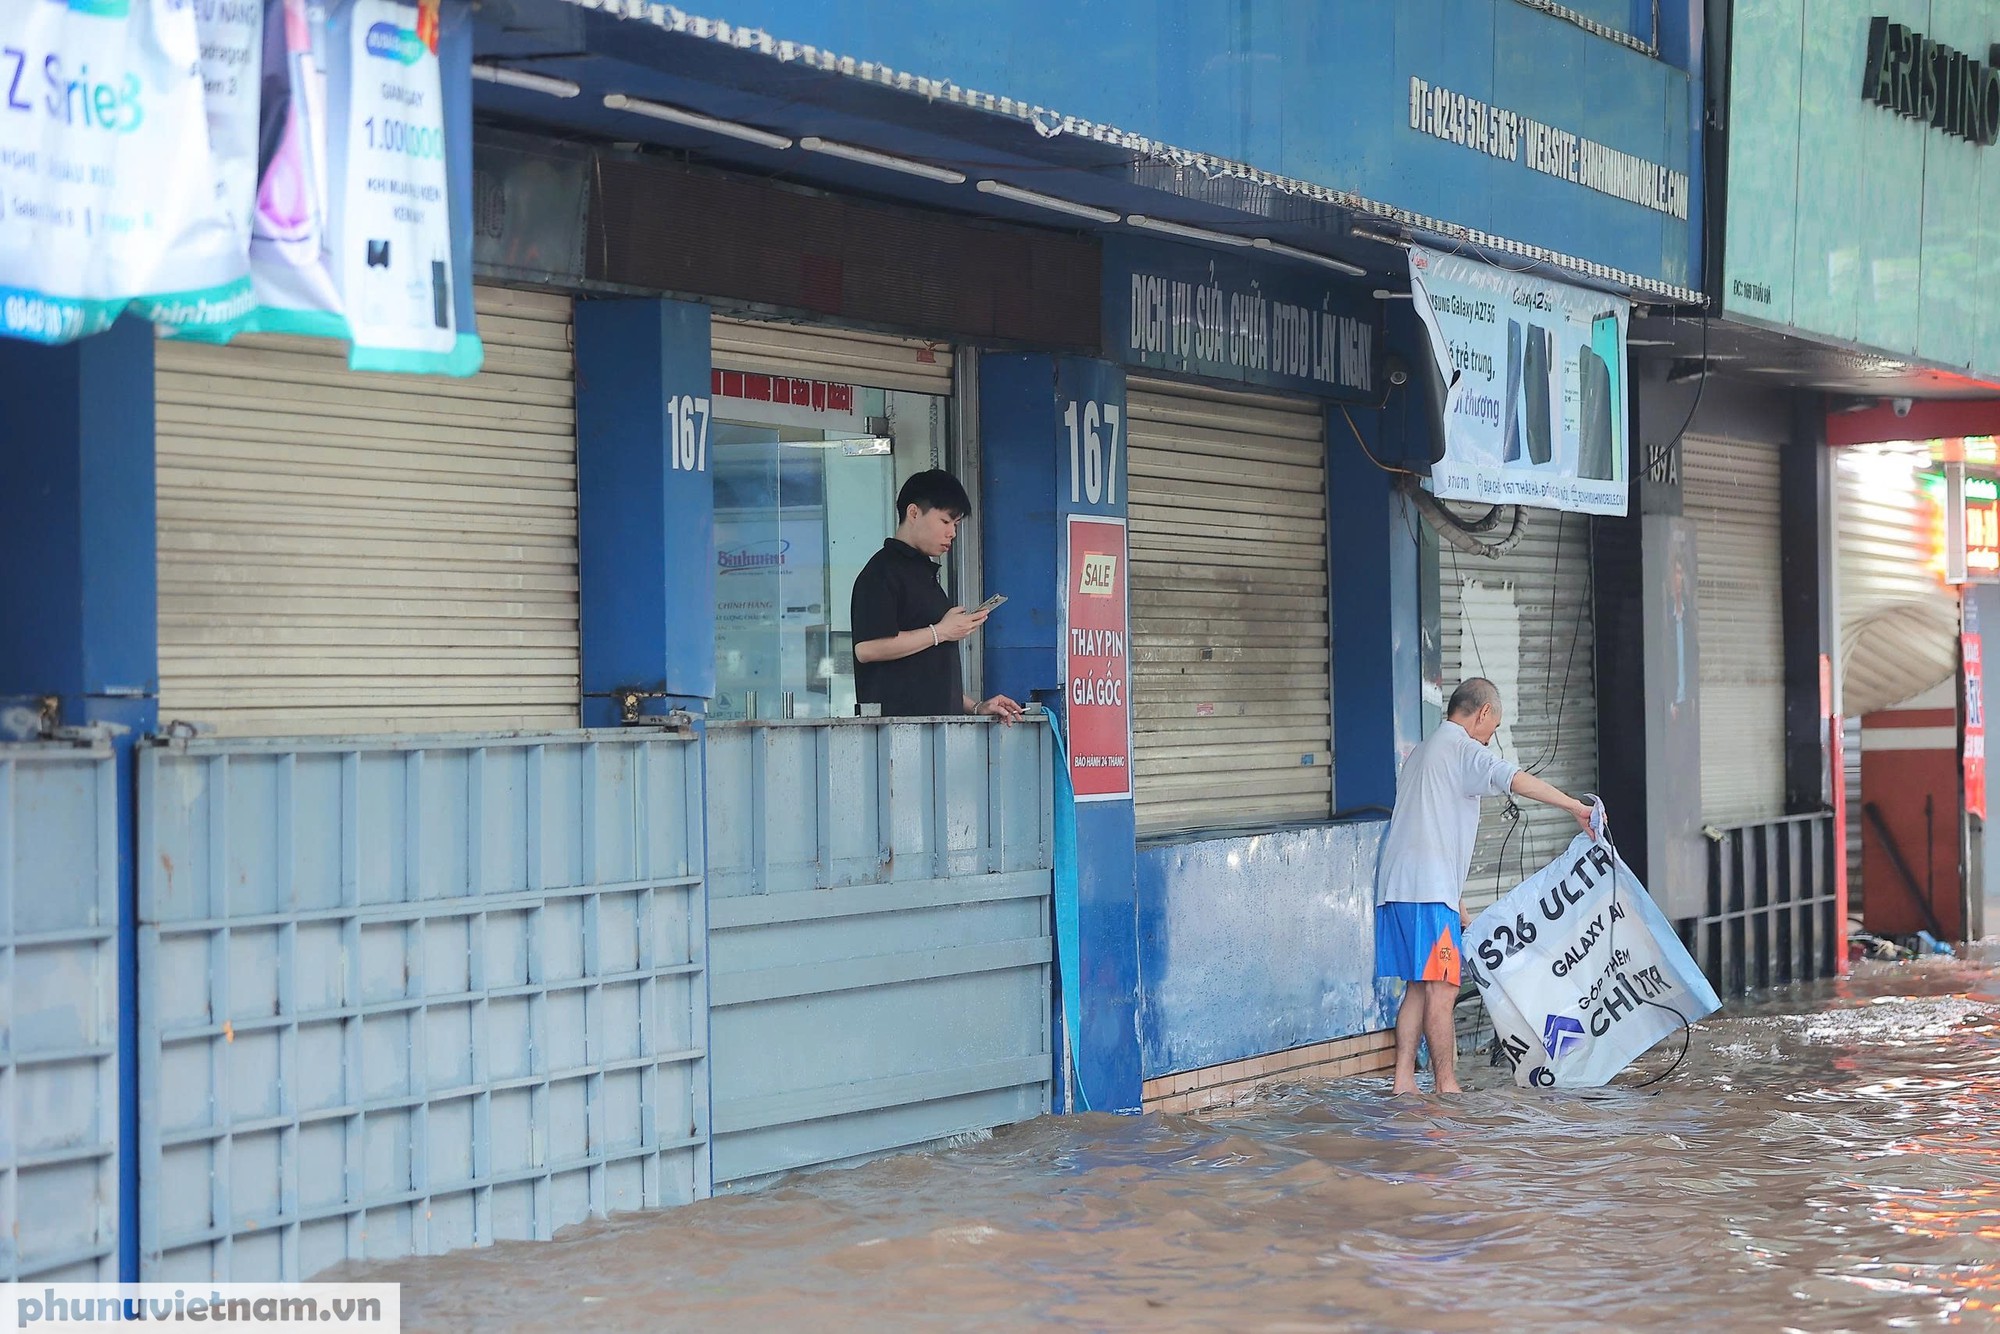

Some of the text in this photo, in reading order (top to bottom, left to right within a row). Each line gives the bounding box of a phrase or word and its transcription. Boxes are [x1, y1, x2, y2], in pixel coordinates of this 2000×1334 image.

[1862, 16, 2000, 146] ARISTINO
[1433, 86, 1466, 145] 0243
[1466, 97, 1489, 154] 514
[1490, 106, 1518, 162] 5163
[1525, 118, 1579, 184] WEBSITE:
[1579, 137, 1689, 221] BINHMINHMOBILE.COM
[1131, 273, 1167, 363] DỊCH
[1172, 281, 1191, 371] VỤ
[1195, 259, 1223, 363] SỬA
[1230, 279, 1267, 370] CHỮA
[1313, 291, 1337, 384] LẤY
[1340, 316, 1372, 392] NGAY
[1451, 294, 1474, 324] Galaxy
[1456, 341, 1469, 369] trẻ
[1471, 348, 1496, 382] trung,
[667, 394, 710, 472] 167
[1465, 388, 1500, 428] thượng
[1064, 400, 1119, 505] 167
[1084, 563, 1110, 587] SALE
[1071, 628, 1123, 657] THAY PIN
[1073, 661, 1122, 707] GIÁ GỐC
[1478, 912, 1537, 971] S26
[1552, 902, 1625, 977] GALAXY AI
